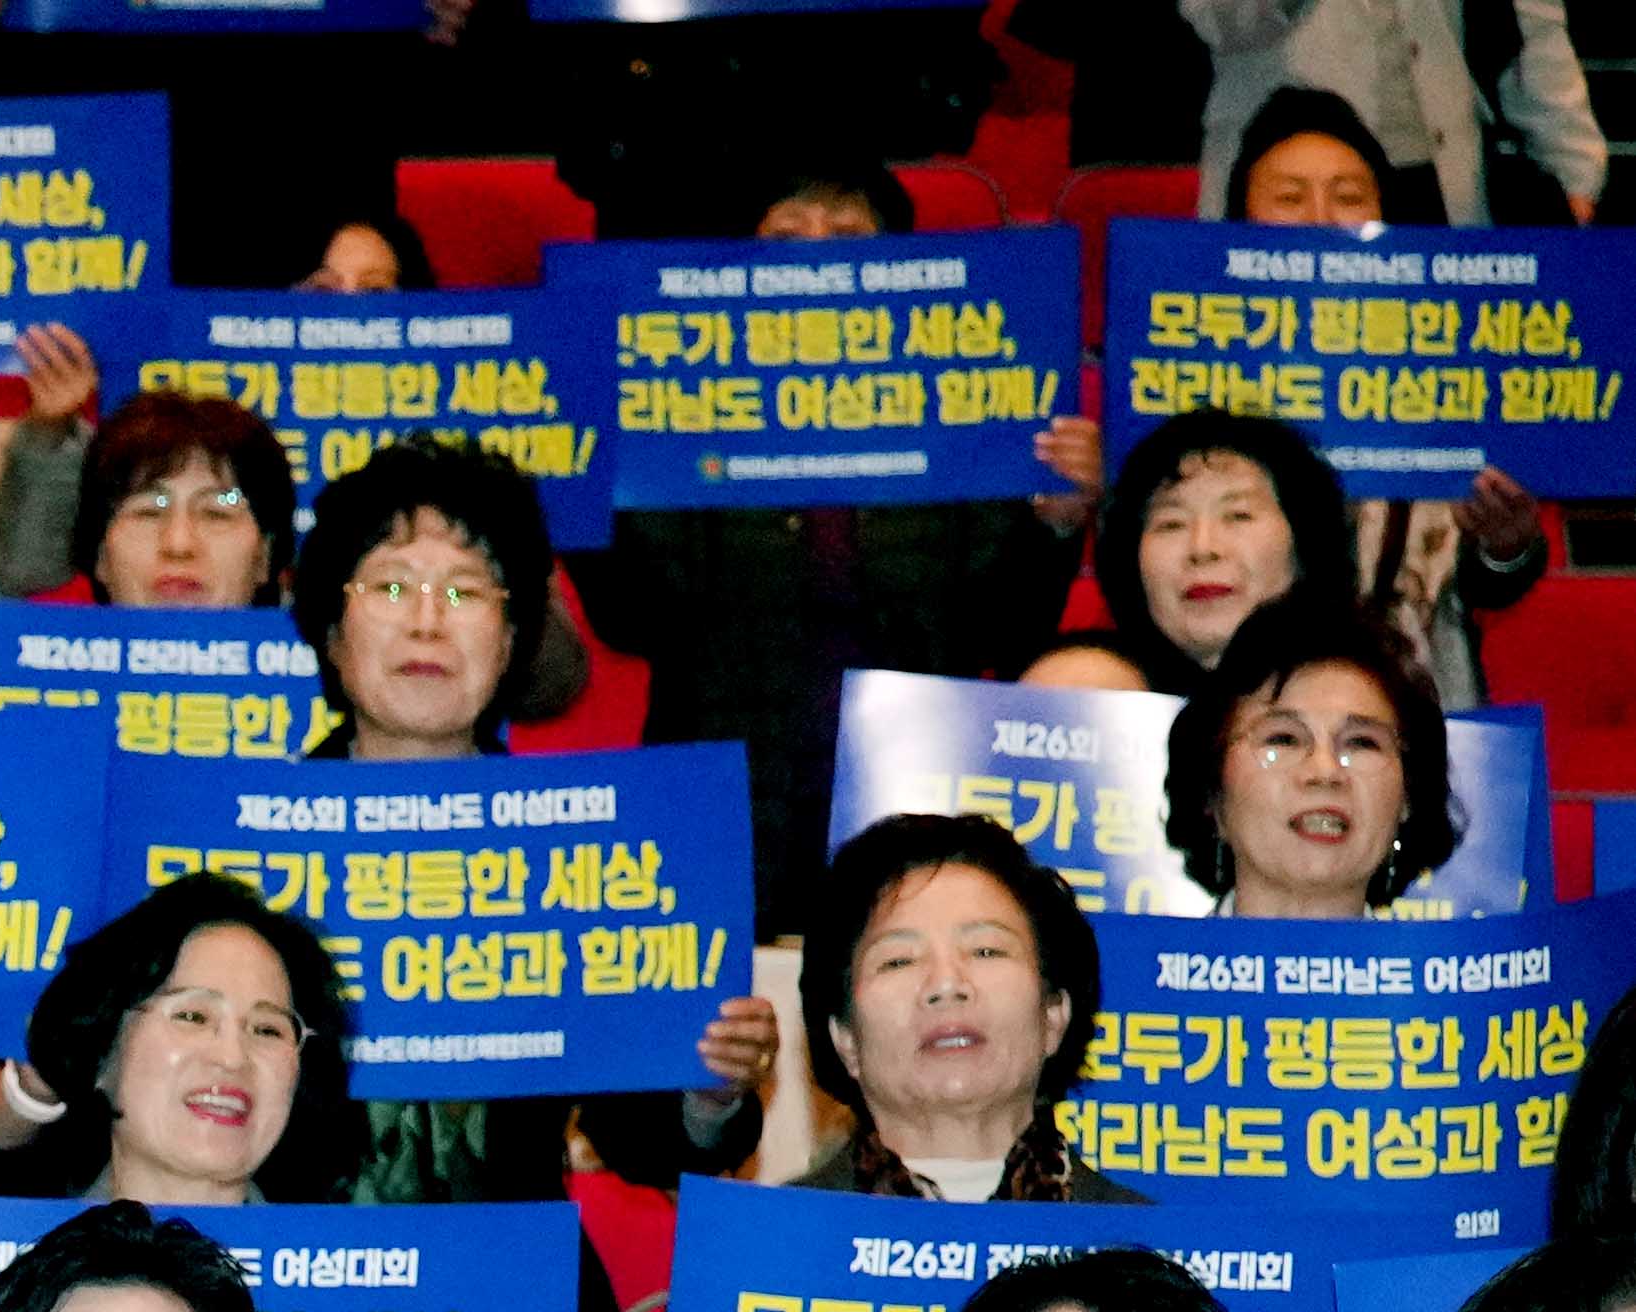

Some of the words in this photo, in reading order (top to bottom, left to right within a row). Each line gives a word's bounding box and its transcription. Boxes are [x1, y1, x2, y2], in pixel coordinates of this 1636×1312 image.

[902, 301, 1016, 360] 세상,
[1147, 292, 1299, 352] 모두가
[1309, 297, 1462, 356] 평등한
[1469, 300, 1582, 359] 세상,
[776, 372, 927, 431] 여성과
[1337, 366, 1489, 423] 여성과
[1499, 367, 1621, 423] 함께!
[236, 794, 347, 833] 제26회
[353, 793, 485, 833] 전라남도
[491, 785, 617, 827] 여성대회
[342, 846, 530, 921] 평등한
[540, 840, 676, 915] 세상,
[381, 929, 568, 1002] 여성과
[578, 922, 727, 996] 함께!
[1156, 952, 1265, 993] 제26회
[1274, 956, 1414, 996] 전라남도
[1423, 946, 1551, 994] 여성대회
[1264, 1016, 1465, 1090] 평등한
[1306, 1102, 1503, 1180] 여성과
[272, 1247, 419, 1288] 여성대회
[849, 1237, 977, 1281] 제26회
